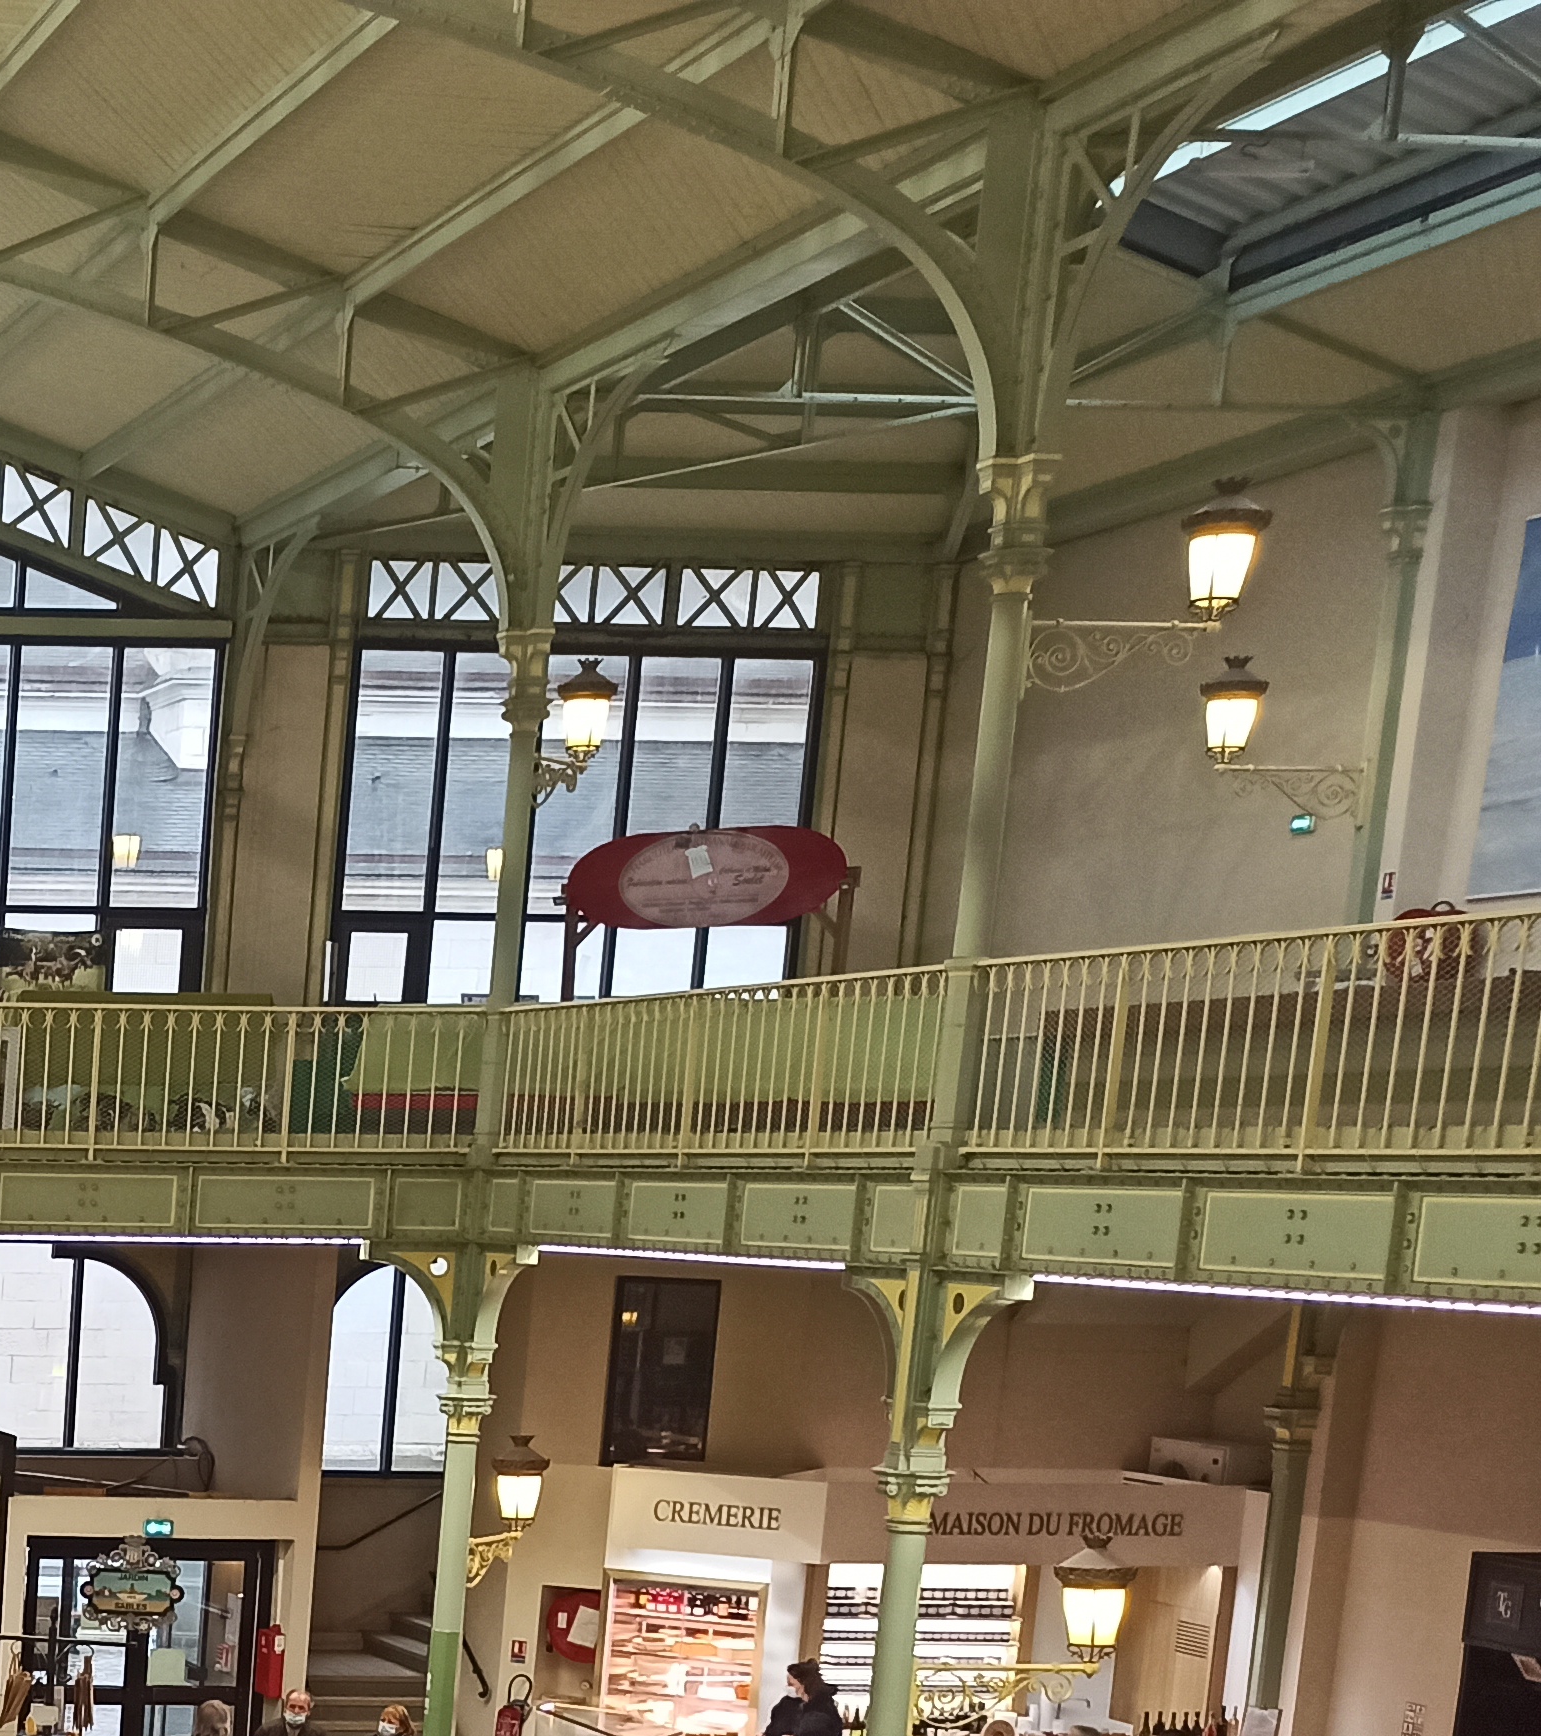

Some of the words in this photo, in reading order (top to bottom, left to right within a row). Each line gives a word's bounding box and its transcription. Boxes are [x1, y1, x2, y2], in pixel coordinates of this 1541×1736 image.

[653, 1499, 783, 1532] CREMERIE
[930, 1511, 1022, 1537] MAISON
[1026, 1511, 1061, 1537] DU
[1067, 1511, 1184, 1538] FROMAGE
